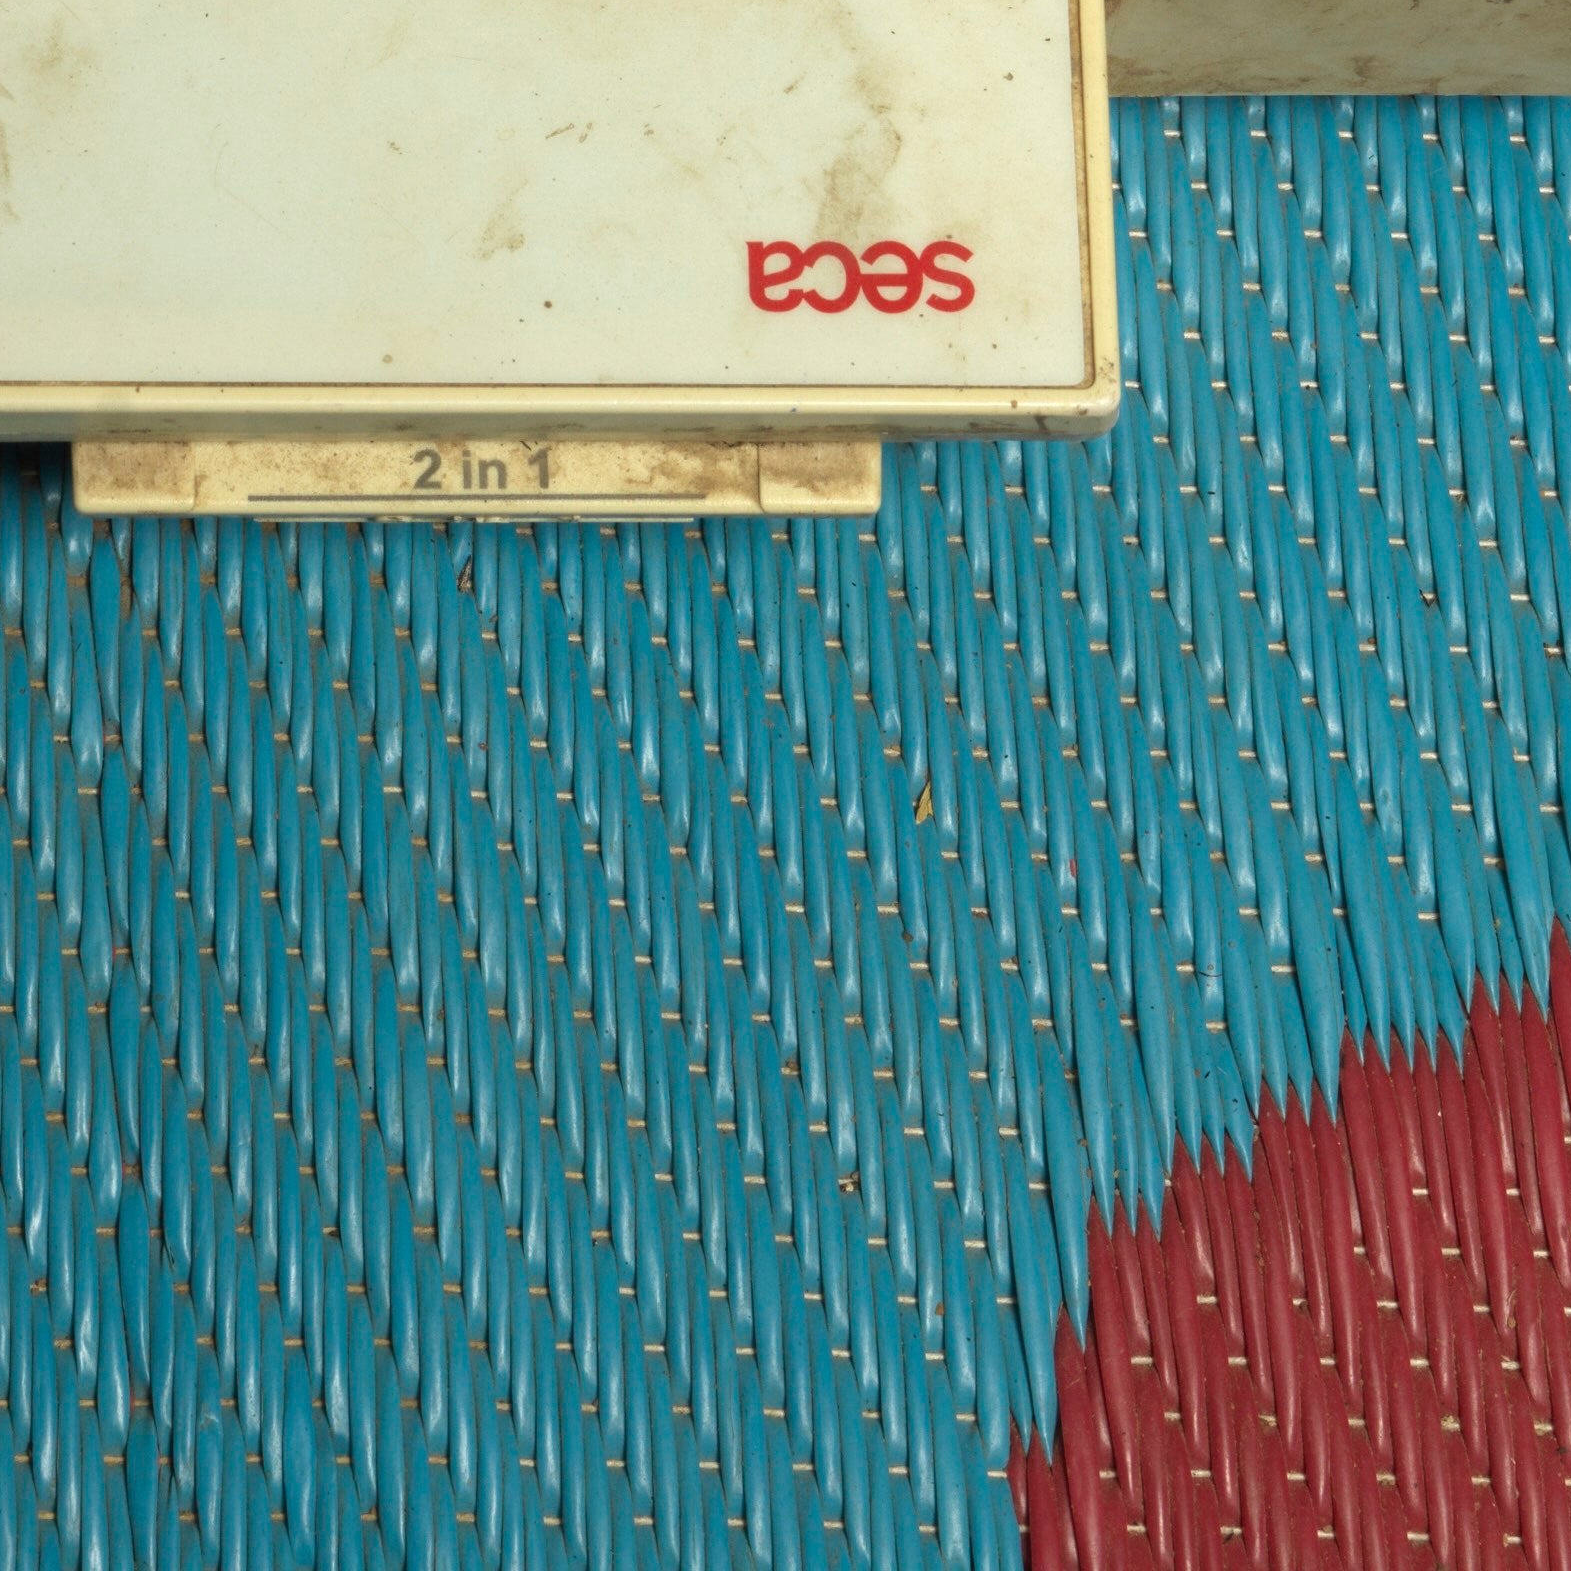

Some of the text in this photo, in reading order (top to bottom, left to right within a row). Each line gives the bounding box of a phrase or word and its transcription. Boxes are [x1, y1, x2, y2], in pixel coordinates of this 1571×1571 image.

[745, 239, 976, 314] seca
[412, 446, 553, 491] 2 in 1
